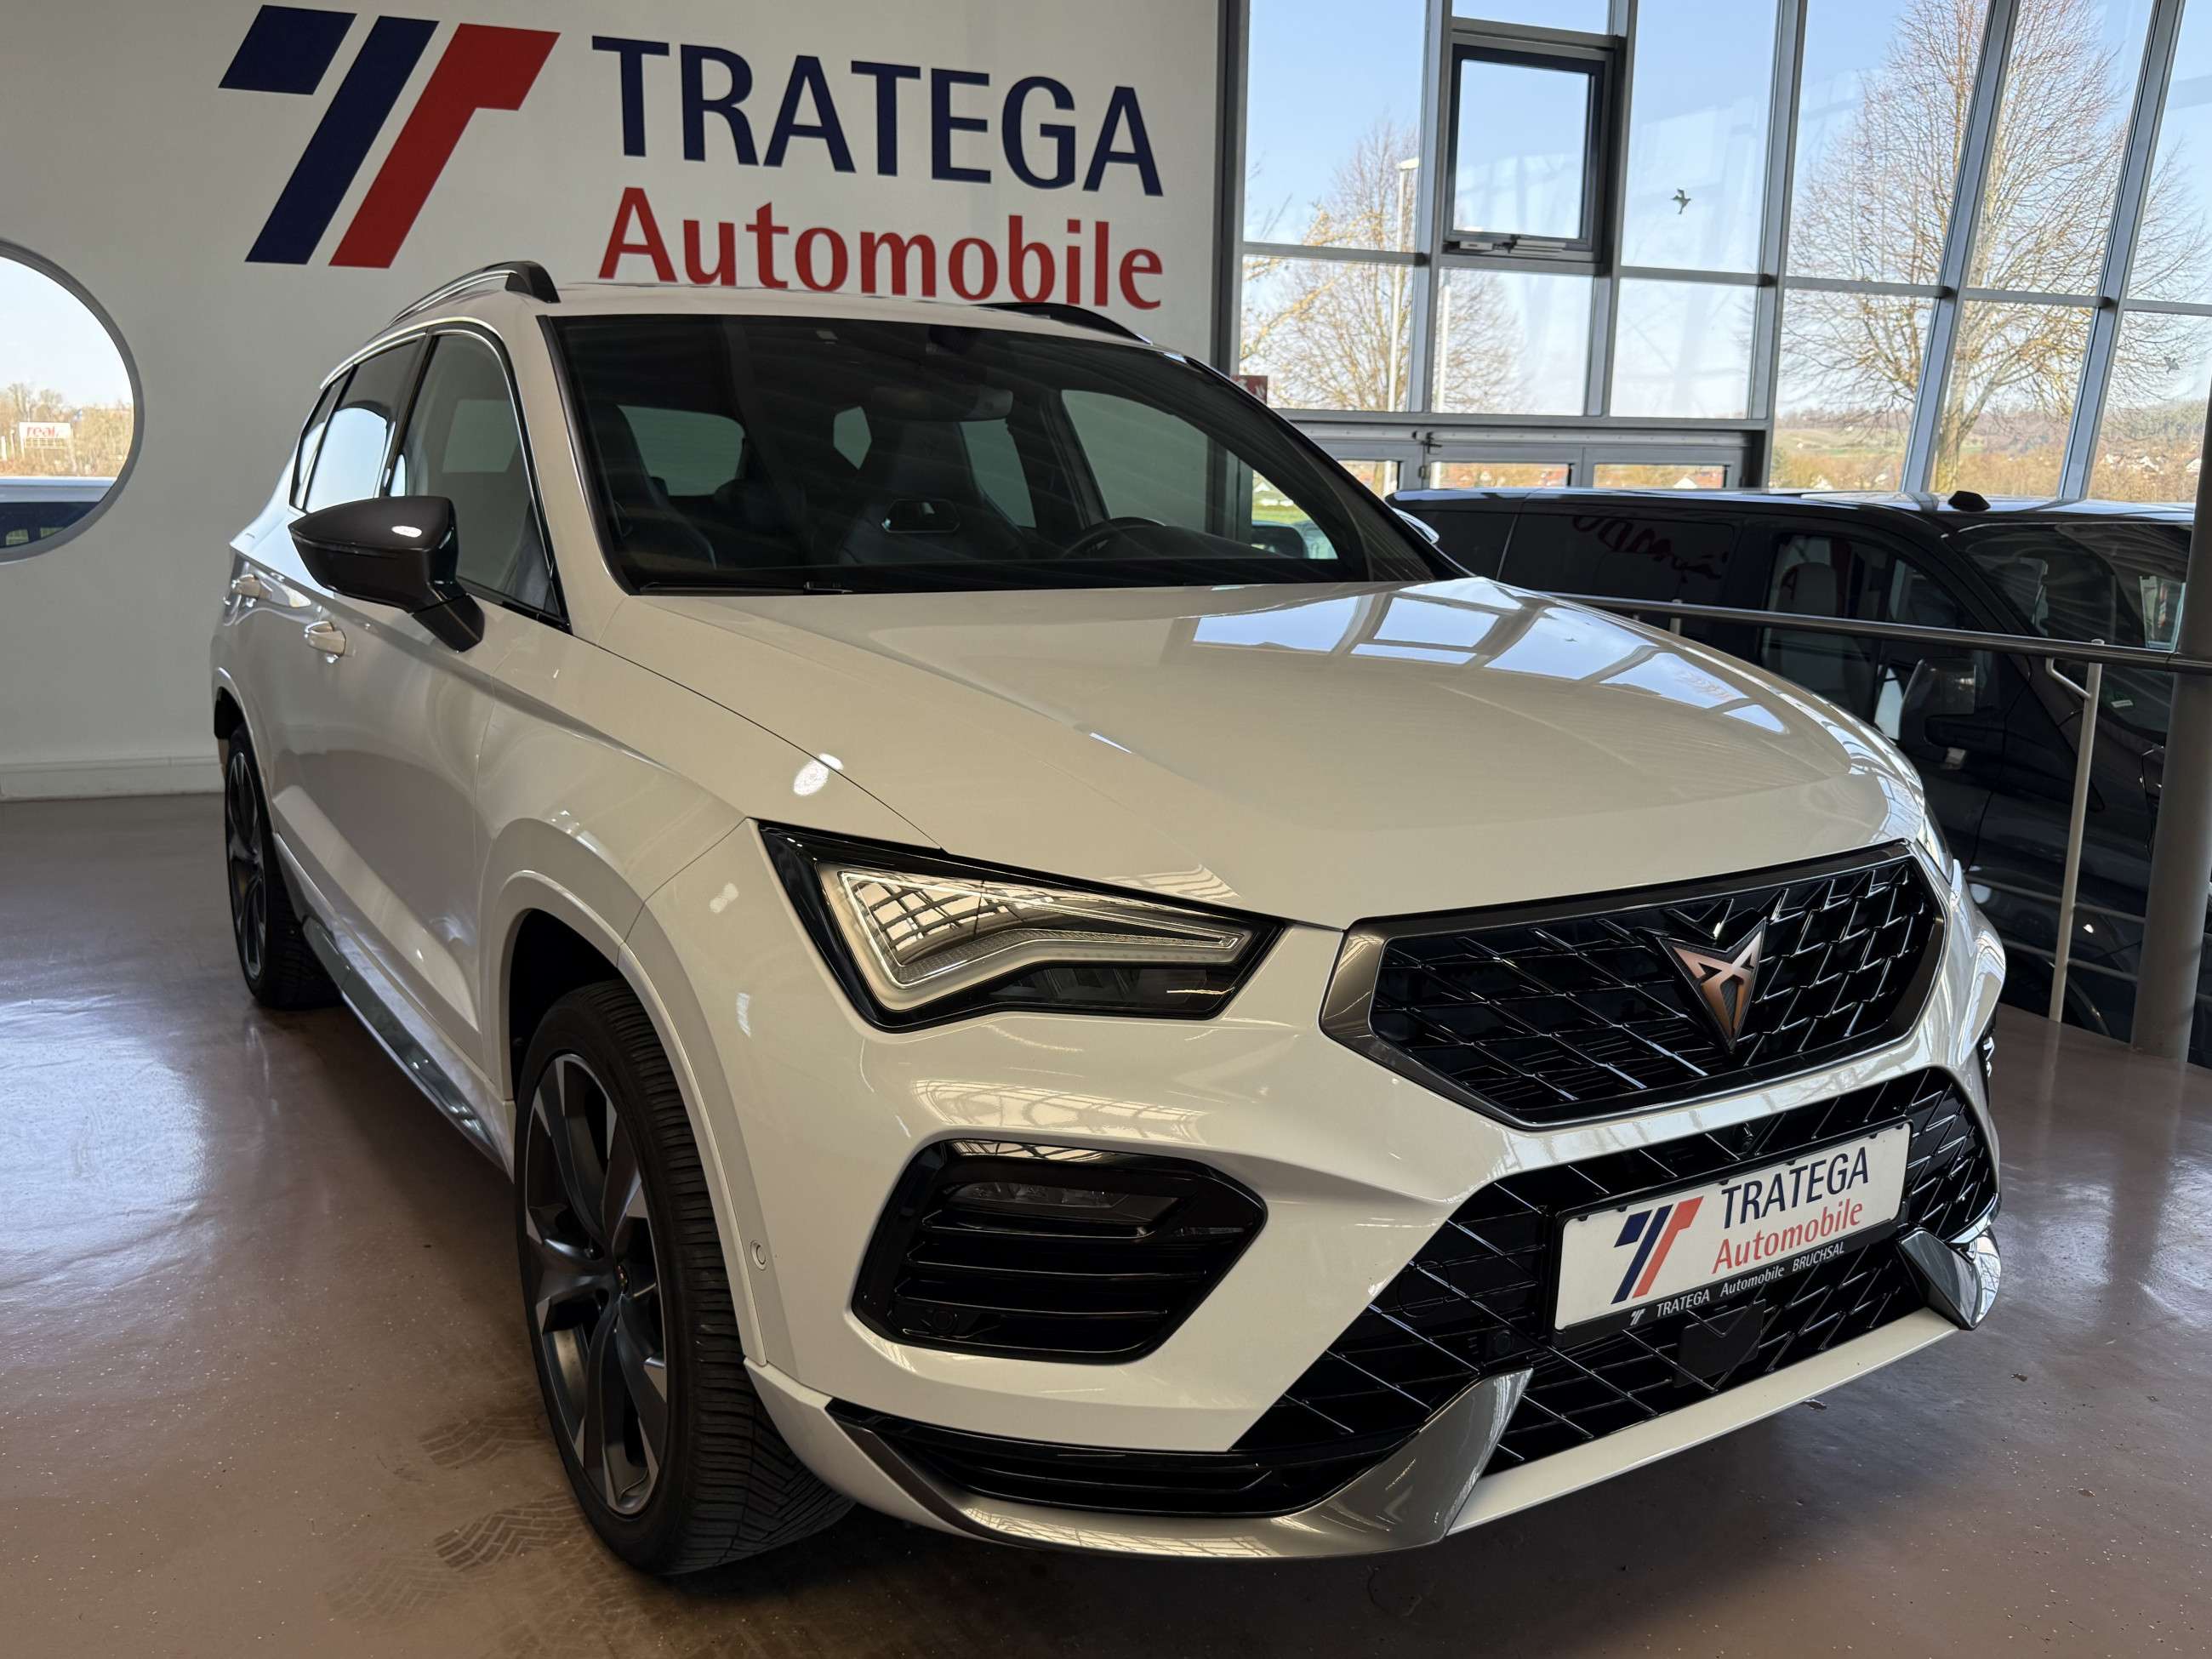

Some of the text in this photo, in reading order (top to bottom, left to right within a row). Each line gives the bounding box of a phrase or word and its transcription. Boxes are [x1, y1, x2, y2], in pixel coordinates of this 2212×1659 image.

[592, 35, 1163, 197] TRATEGA
[598, 186, 1163, 310] Automobile
[1721, 1146, 1869, 1229] TRATEGA
[1712, 1197, 1863, 1274] Automobile
[1657, 1240, 1845, 1318] TRATEGA Automobile BRUCHSAL
